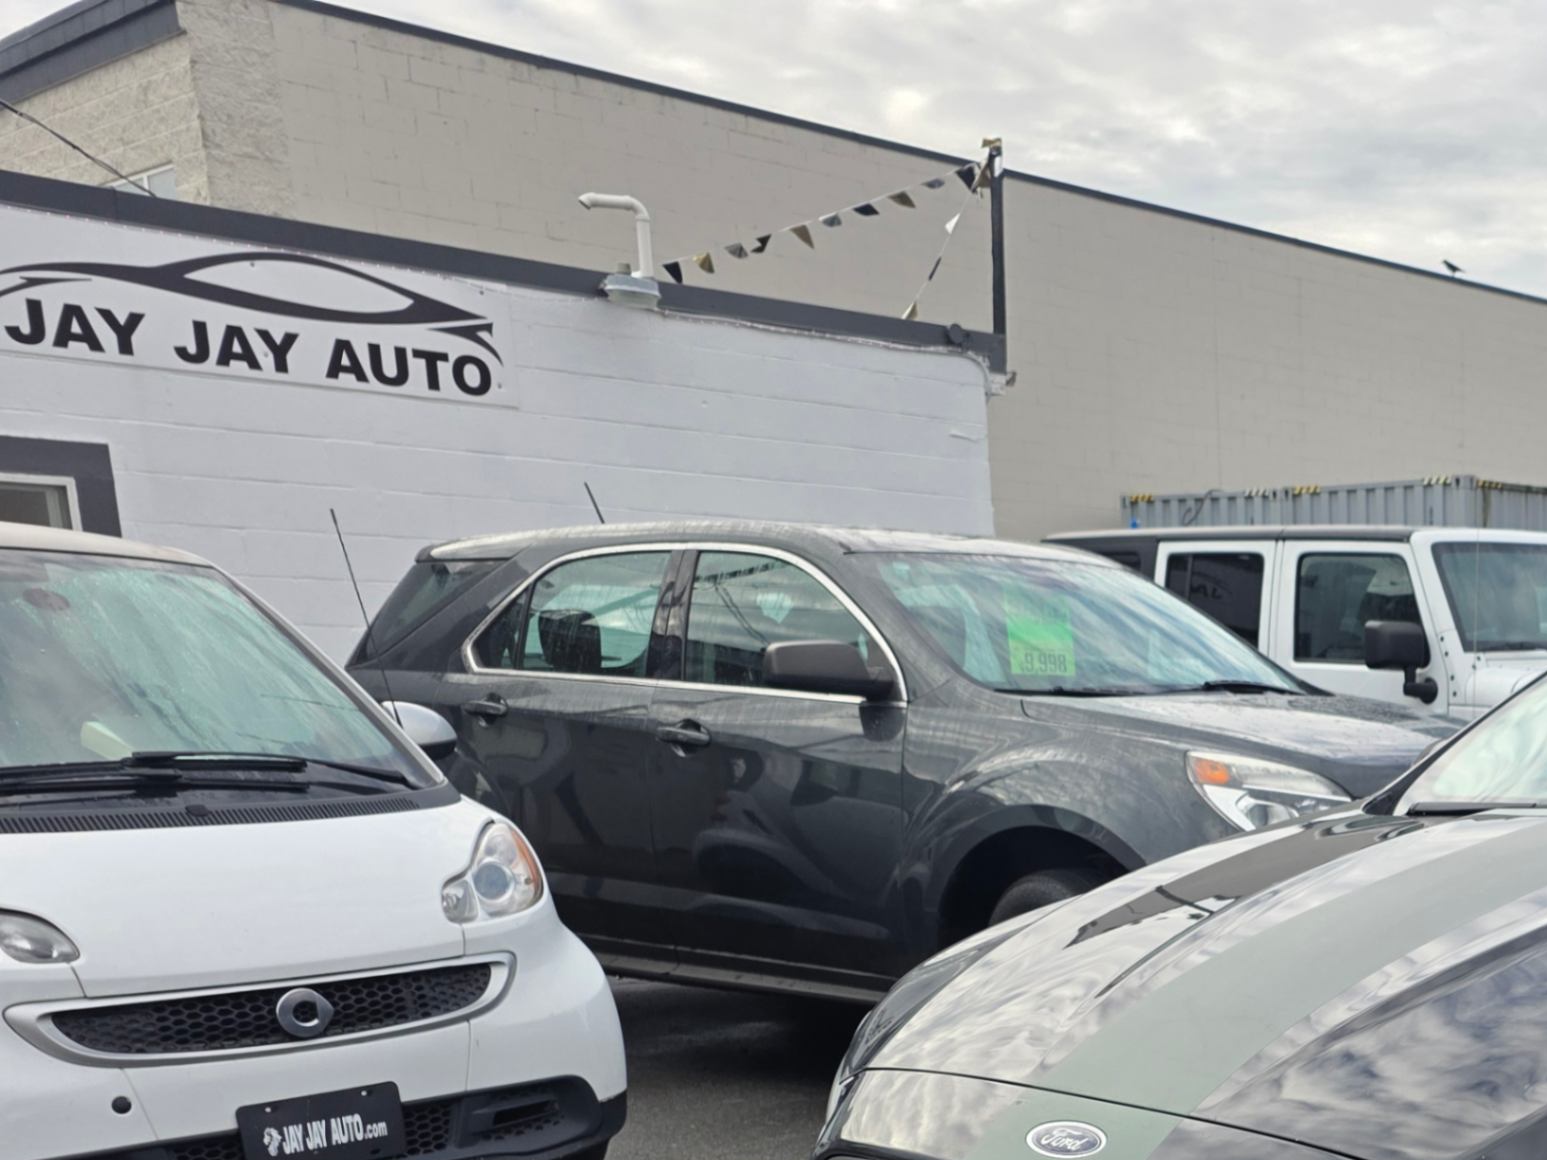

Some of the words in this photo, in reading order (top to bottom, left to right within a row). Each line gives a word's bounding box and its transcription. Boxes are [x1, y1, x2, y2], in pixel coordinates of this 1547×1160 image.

[4, 298, 146, 356] JAY
[173, 320, 300, 374] JAY
[325, 339, 493, 396] AUTO
[282, 1123, 305, 1155] JAY
[306, 1119, 328, 1150] JAY
[1040, 1127, 1089, 1151] Ford
